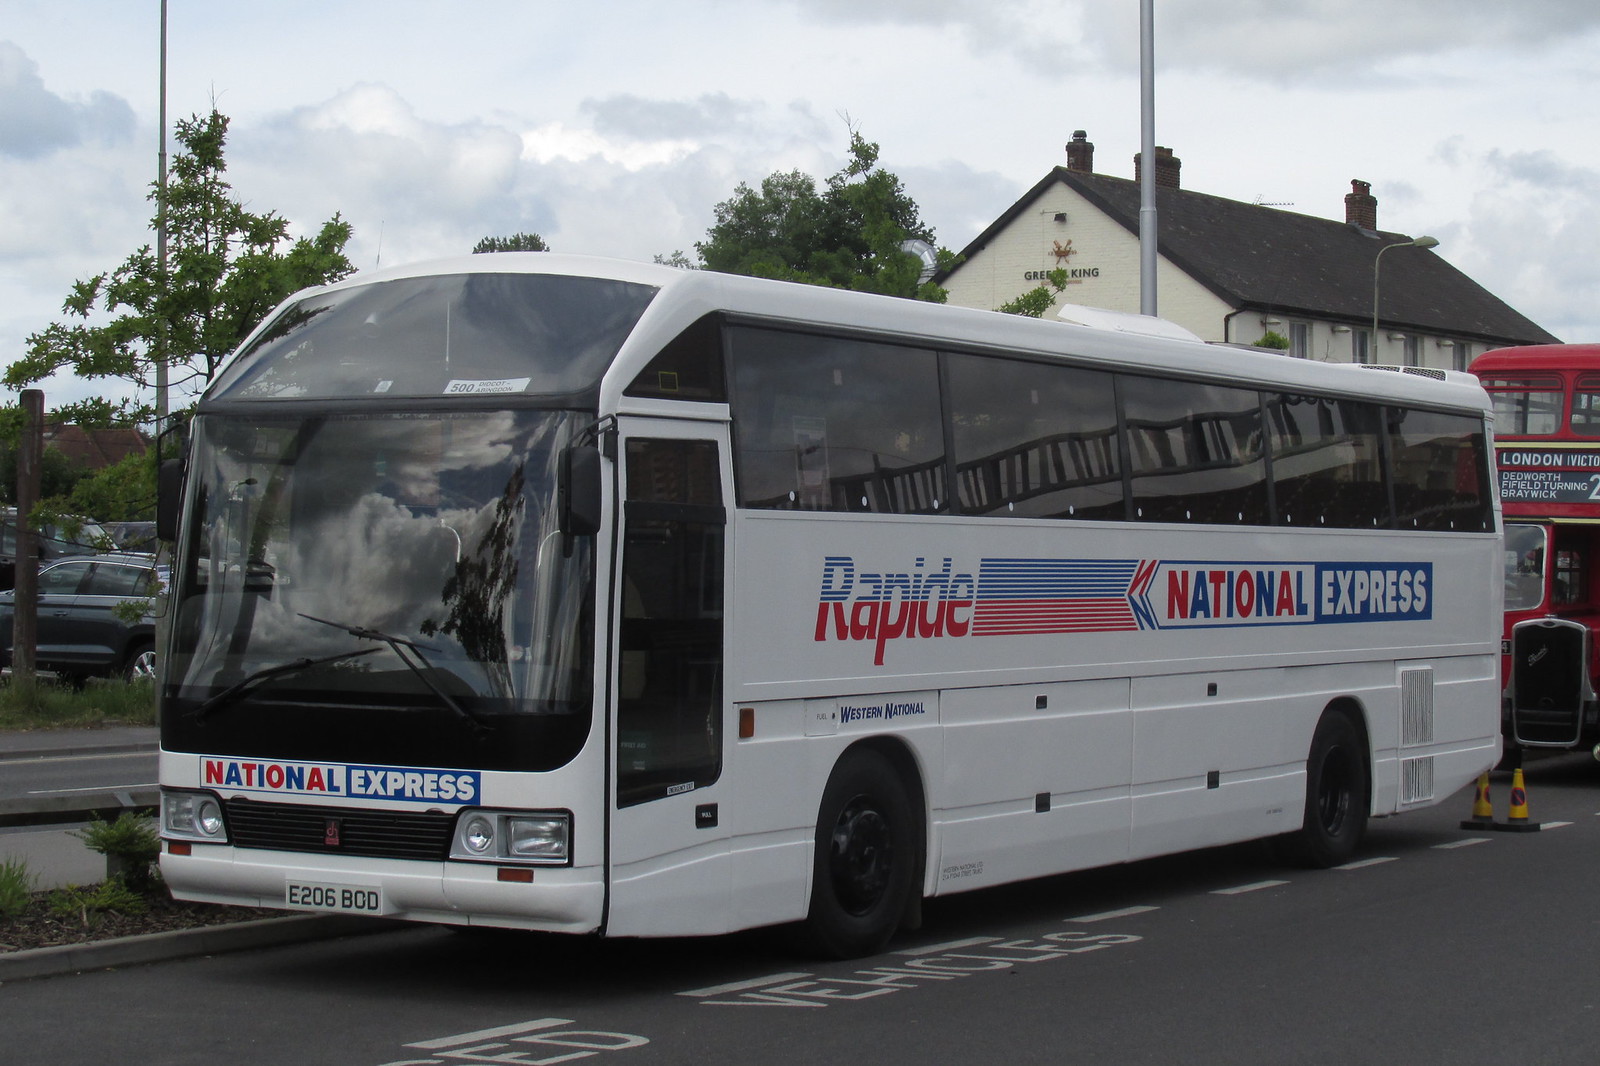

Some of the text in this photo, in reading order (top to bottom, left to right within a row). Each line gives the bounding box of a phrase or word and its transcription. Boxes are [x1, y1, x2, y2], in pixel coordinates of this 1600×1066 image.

[1024, 268, 1100, 280] GREE KING
[450, 383, 475, 393] 500
[1502, 452, 1563, 466] LONDON
[1502, 472, 1561, 482] DEDWORTH
[1502, 481, 1588, 491] FIFIELD TURNING
[1501, 490, 1557, 498] BRAYWICK
[1167, 569, 1427, 619] NATIONAL EXPRESS
[814, 556, 975, 665] Rapide
[840, 702, 925, 724] WESTERN NATIONAL
[205, 760, 475, 801] NATIONAL EXPRESS
[289, 885, 379, 910] E206 BOD
[699, 931, 1143, 1008] VEHICLES
